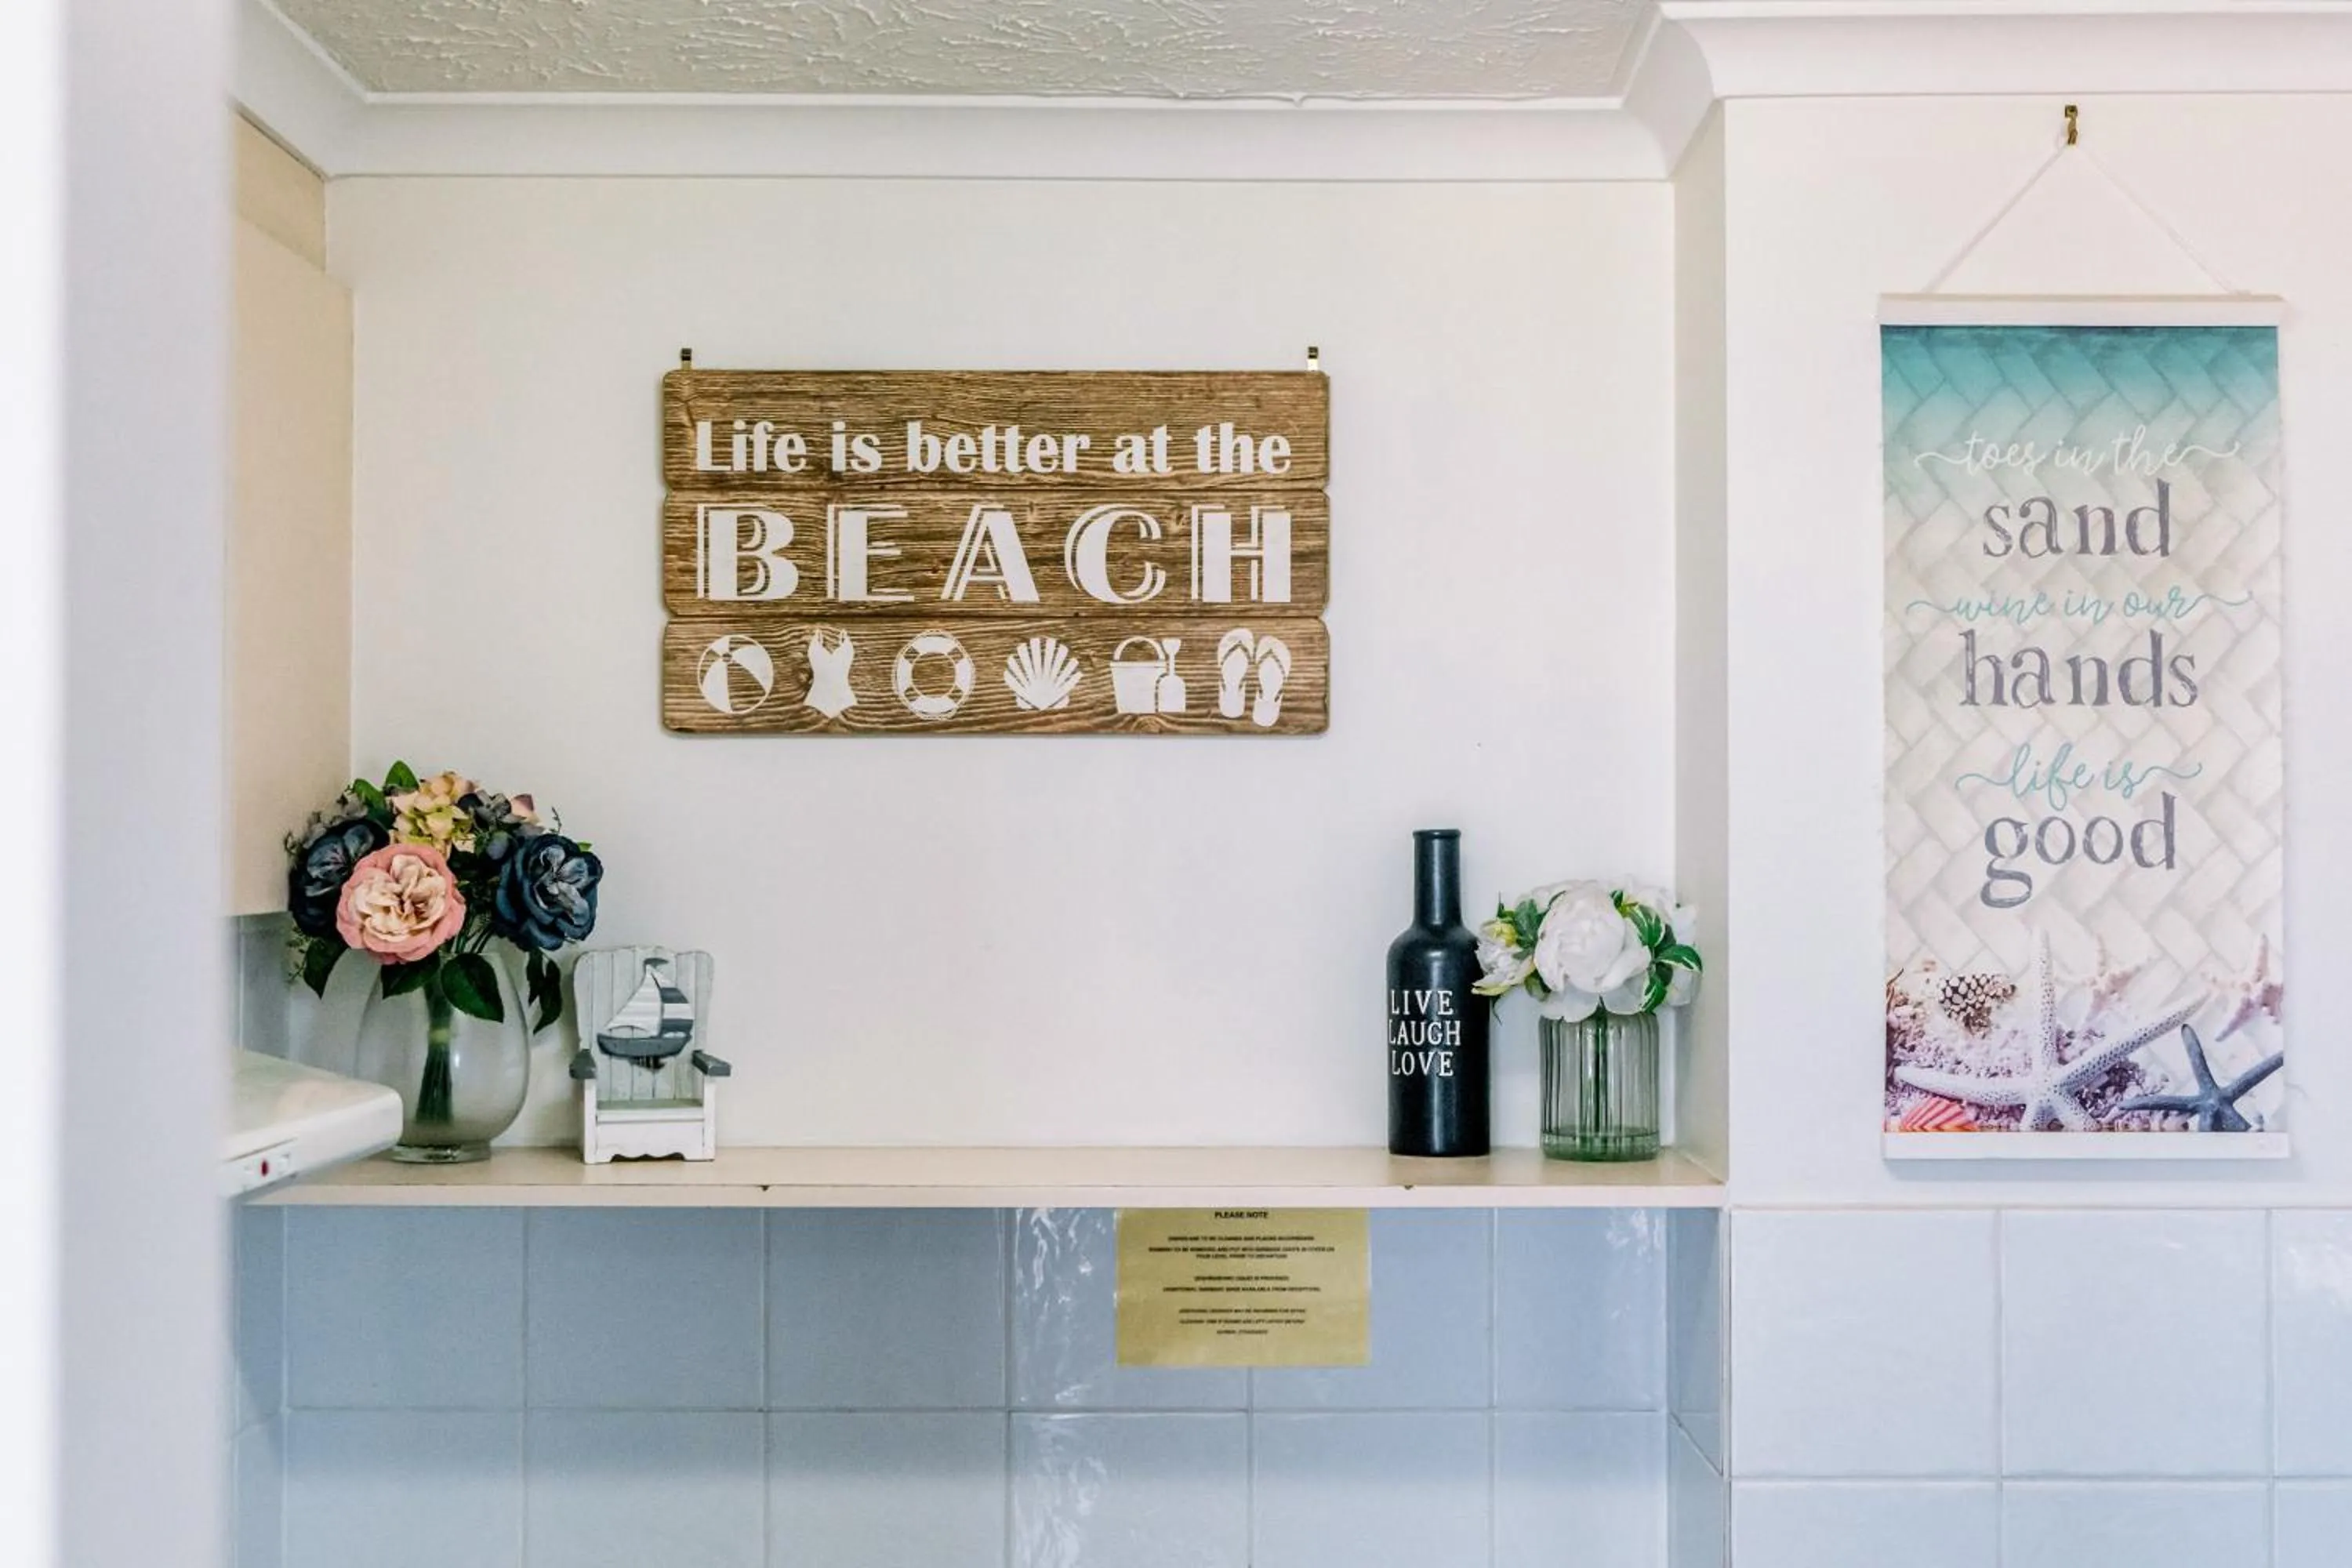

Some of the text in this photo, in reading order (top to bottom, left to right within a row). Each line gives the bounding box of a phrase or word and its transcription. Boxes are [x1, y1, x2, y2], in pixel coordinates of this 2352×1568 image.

[695, 420, 1290, 474] Life is better at the
[1943, 424, 2207, 474] toes in the
[1984, 477, 2170, 557] sand
[696, 503, 1291, 604] BEACH
[1938, 586, 2217, 624] wine in our
[1958, 630, 2199, 708] hands
[1991, 742, 2095, 811] life
[1980, 791, 2176, 909] good
[1391, 989, 1454, 1016] LIVE
[1388, 1018, 1461, 1046] LAUGH
[1392, 1050, 1454, 1077] LOVE
